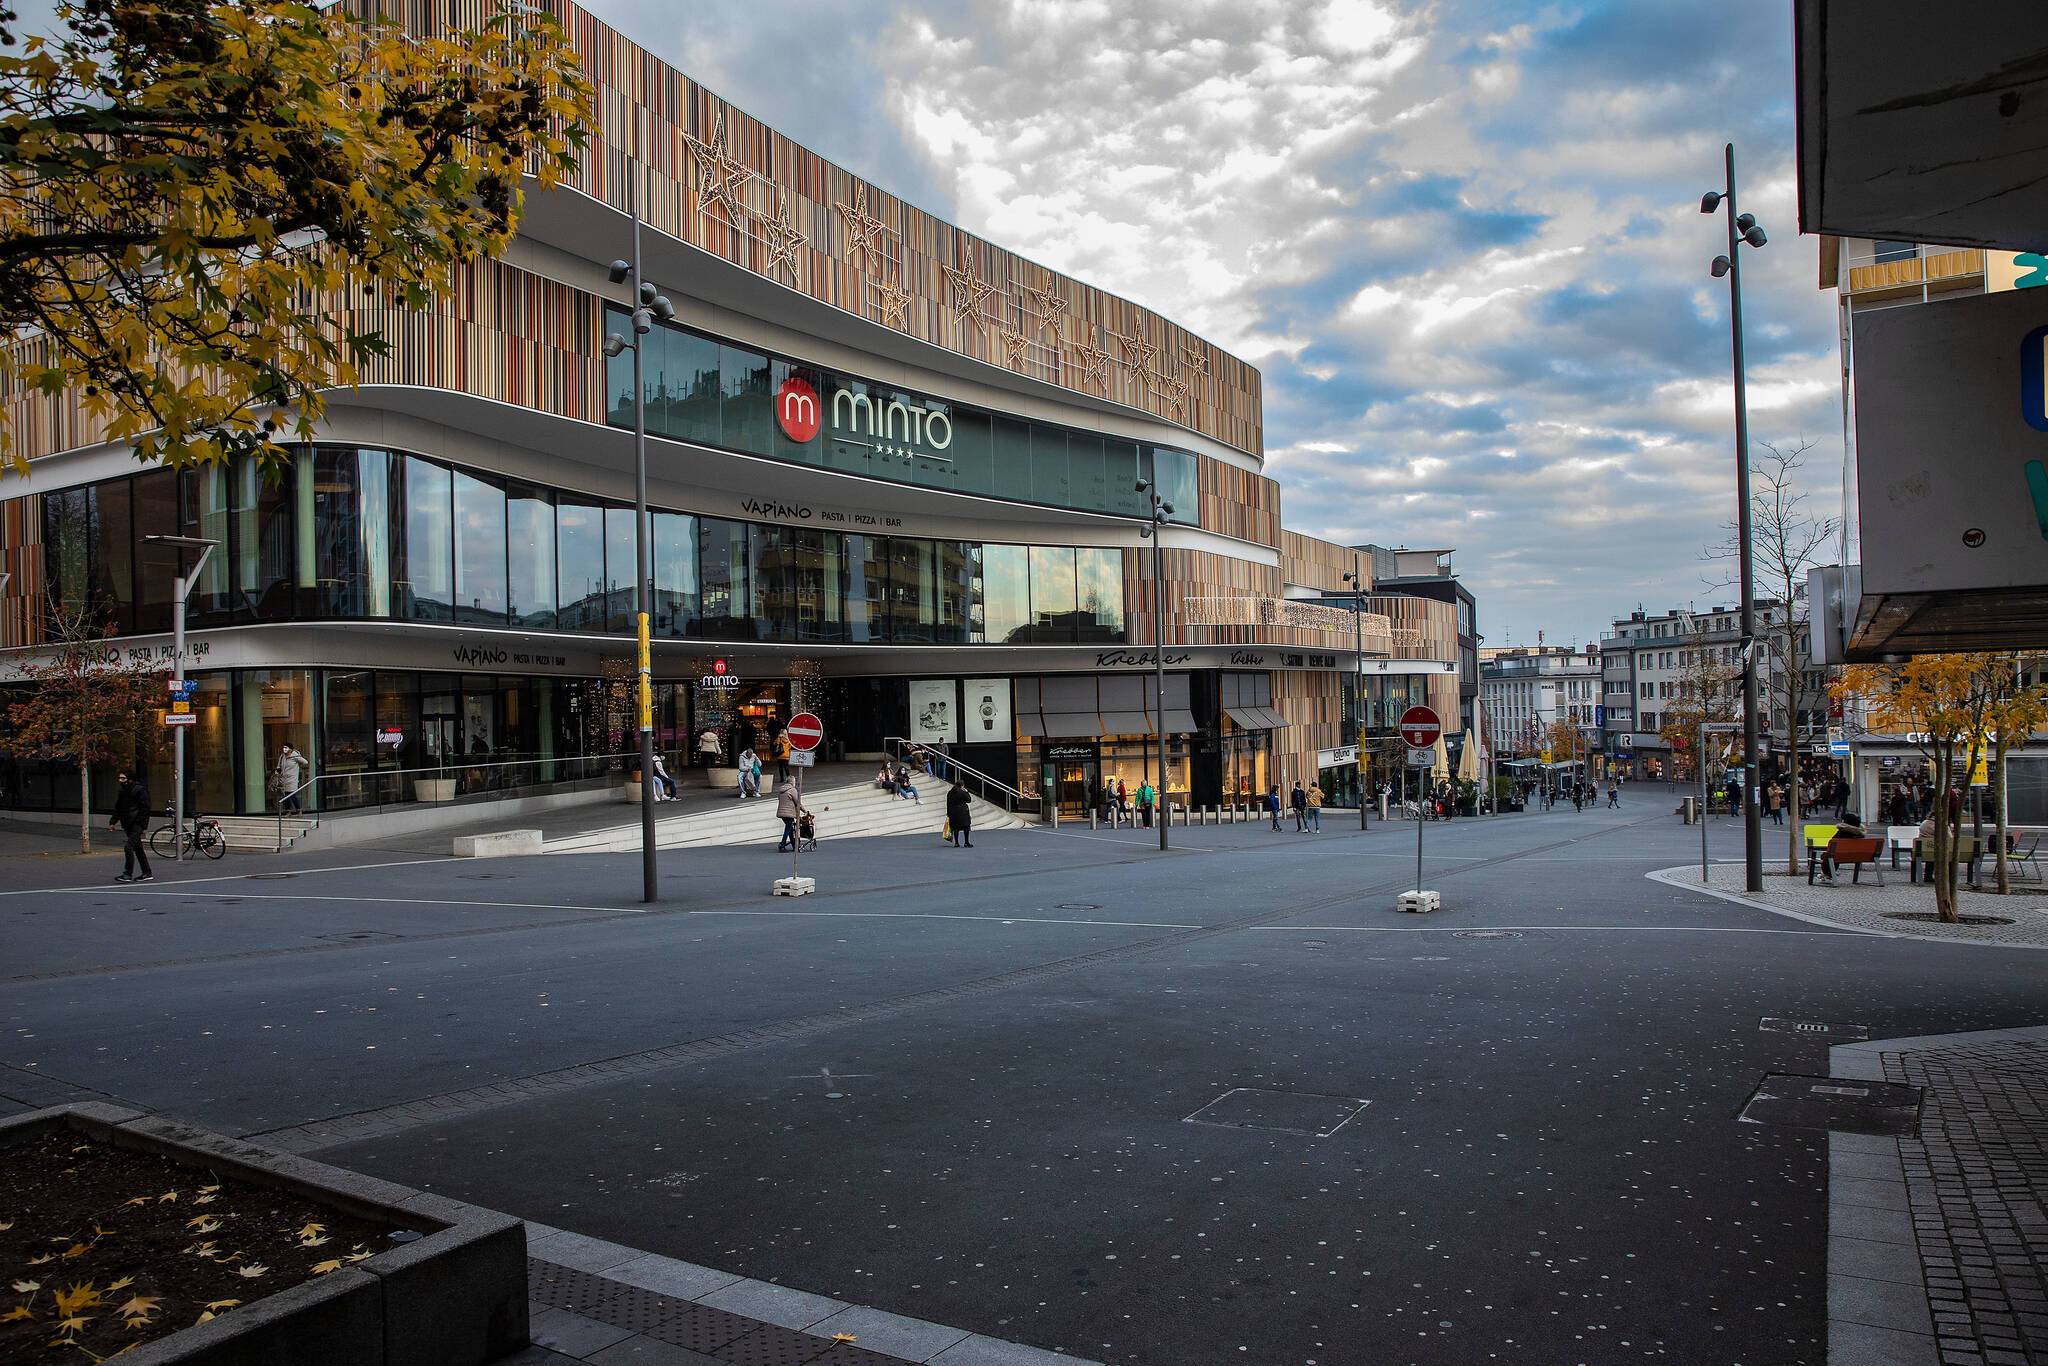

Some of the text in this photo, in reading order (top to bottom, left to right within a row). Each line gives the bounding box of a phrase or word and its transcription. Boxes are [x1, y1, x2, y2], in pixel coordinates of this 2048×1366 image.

[821, 511, 845, 522] PASTA
[855, 514, 876, 525] PIZZA
[886, 518, 901, 528] BAR
[129, 648, 151, 660] PASTA
[193, 642, 209, 655] BAR
[514, 653, 530, 664] PASTA
[536, 655, 549, 666] PIZZA
[556, 656, 566, 666] BAR
